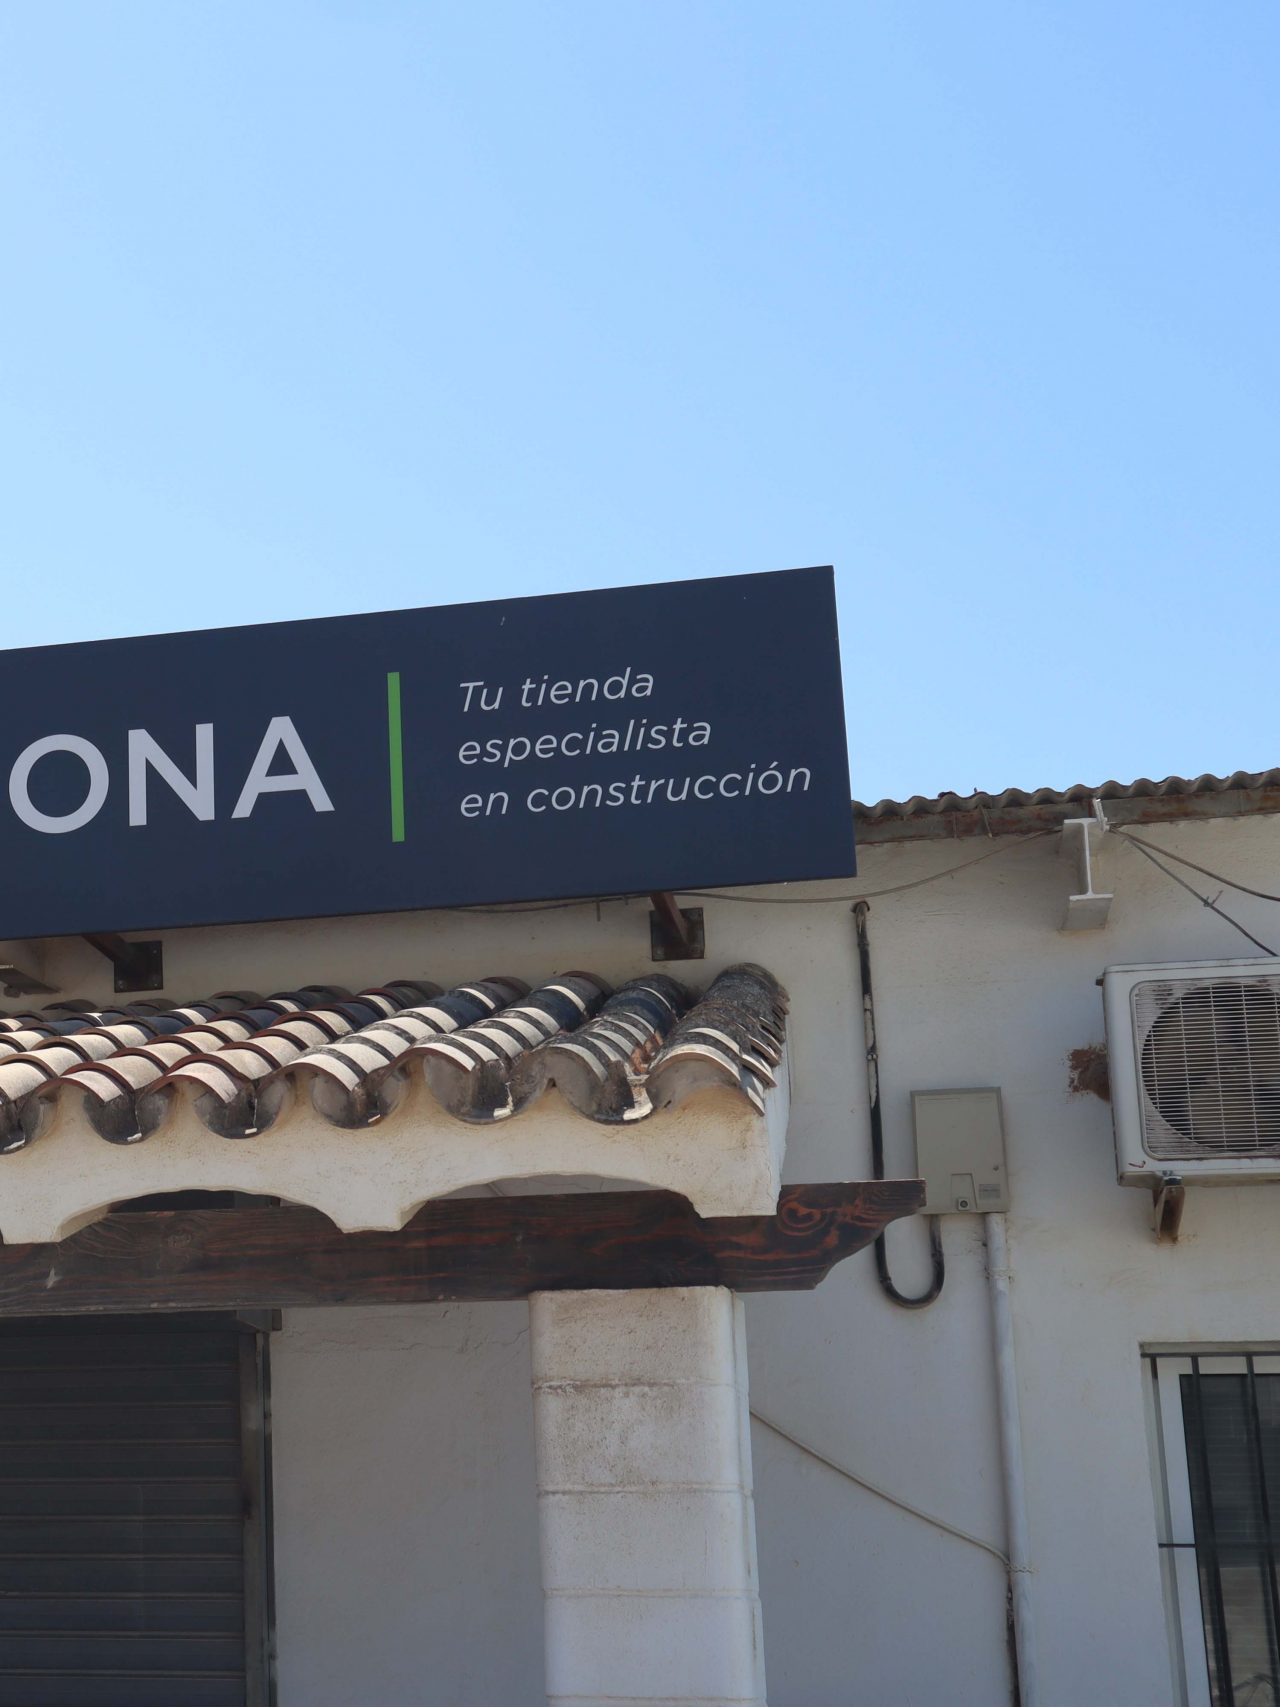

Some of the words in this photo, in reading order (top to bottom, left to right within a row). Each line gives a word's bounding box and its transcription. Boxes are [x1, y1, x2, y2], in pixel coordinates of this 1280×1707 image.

[459, 681, 503, 712] Tu
[521, 666, 654, 707] tienda
[458, 717, 712, 768] especialista
[460, 791, 509, 818] en
[527, 761, 812, 812] construcción
